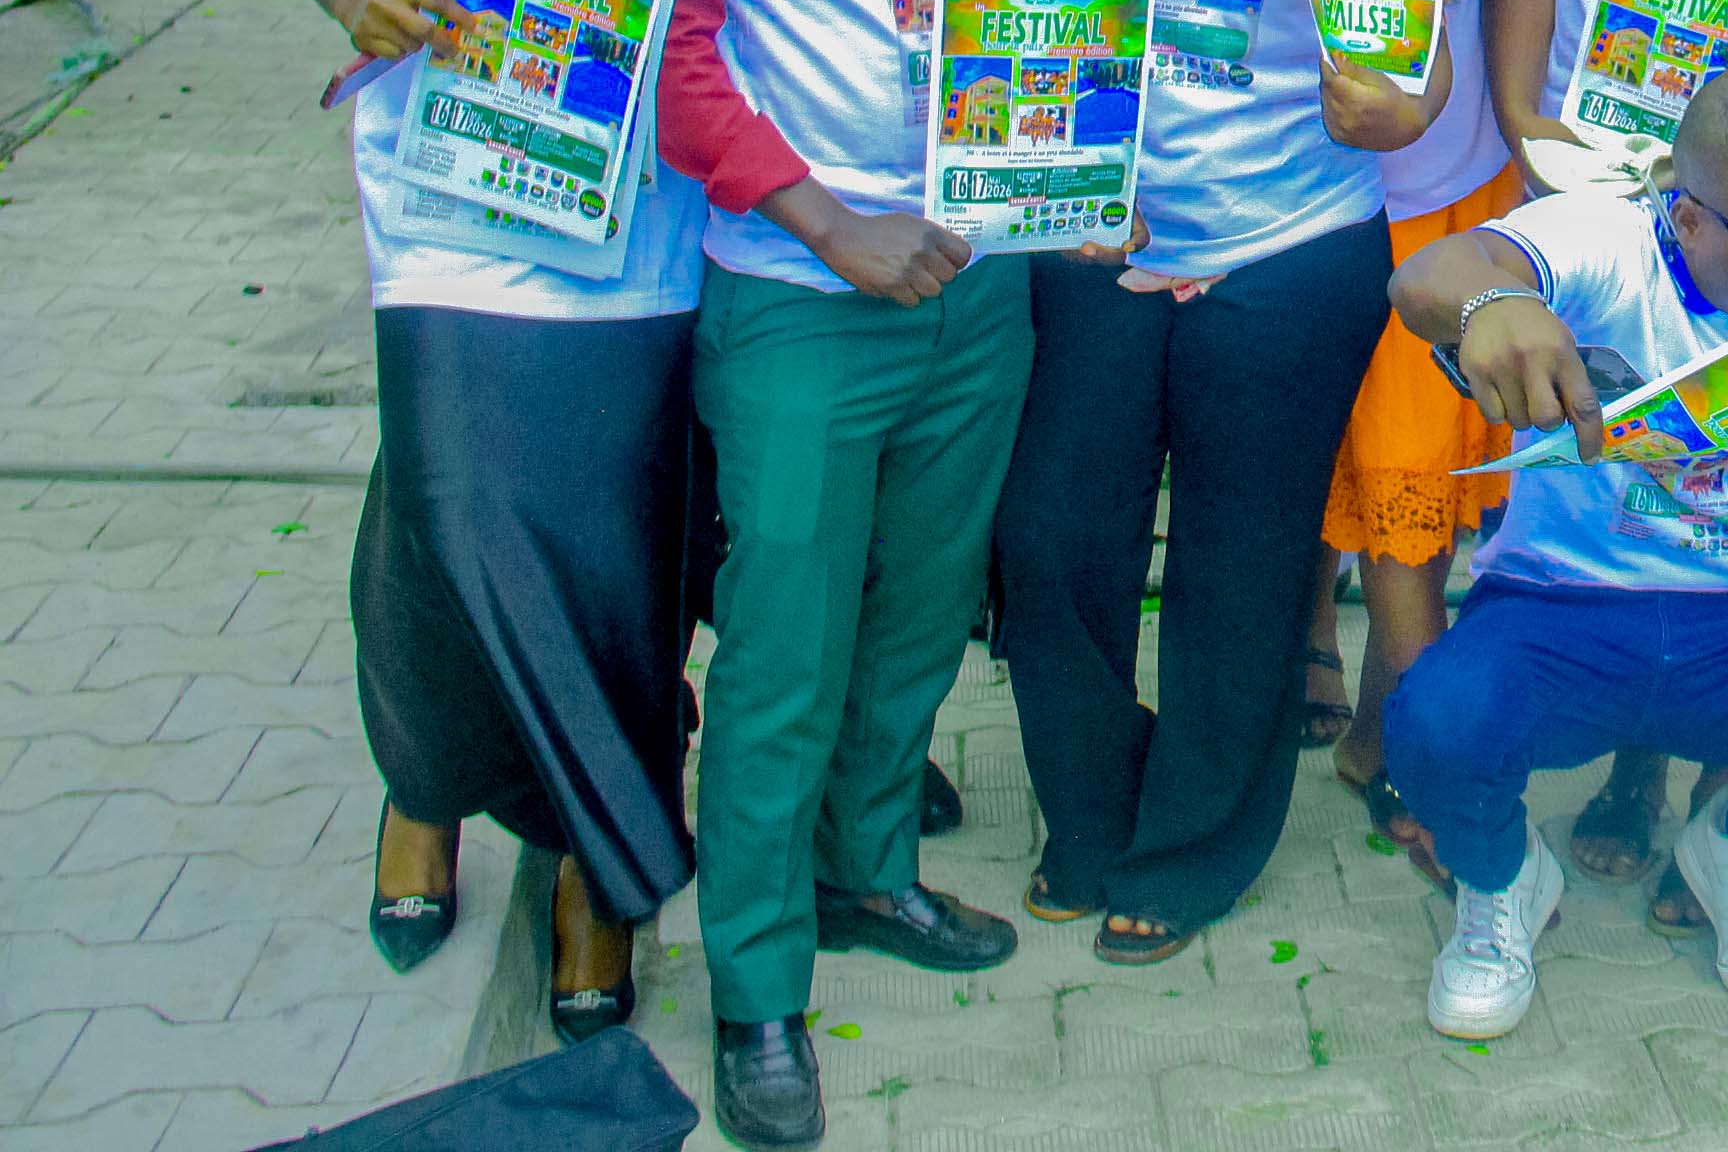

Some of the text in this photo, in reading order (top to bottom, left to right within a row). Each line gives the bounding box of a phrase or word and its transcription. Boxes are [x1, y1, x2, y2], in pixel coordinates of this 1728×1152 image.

[981, 10, 1106, 46] FESTIVAL
[1584, 94, 1604, 122] 16
[1614, 114, 1638, 132] 2026
[951, 170, 969, 200] 16
[971, 170, 988, 200] 17
[987, 184, 1012, 199] 2026
